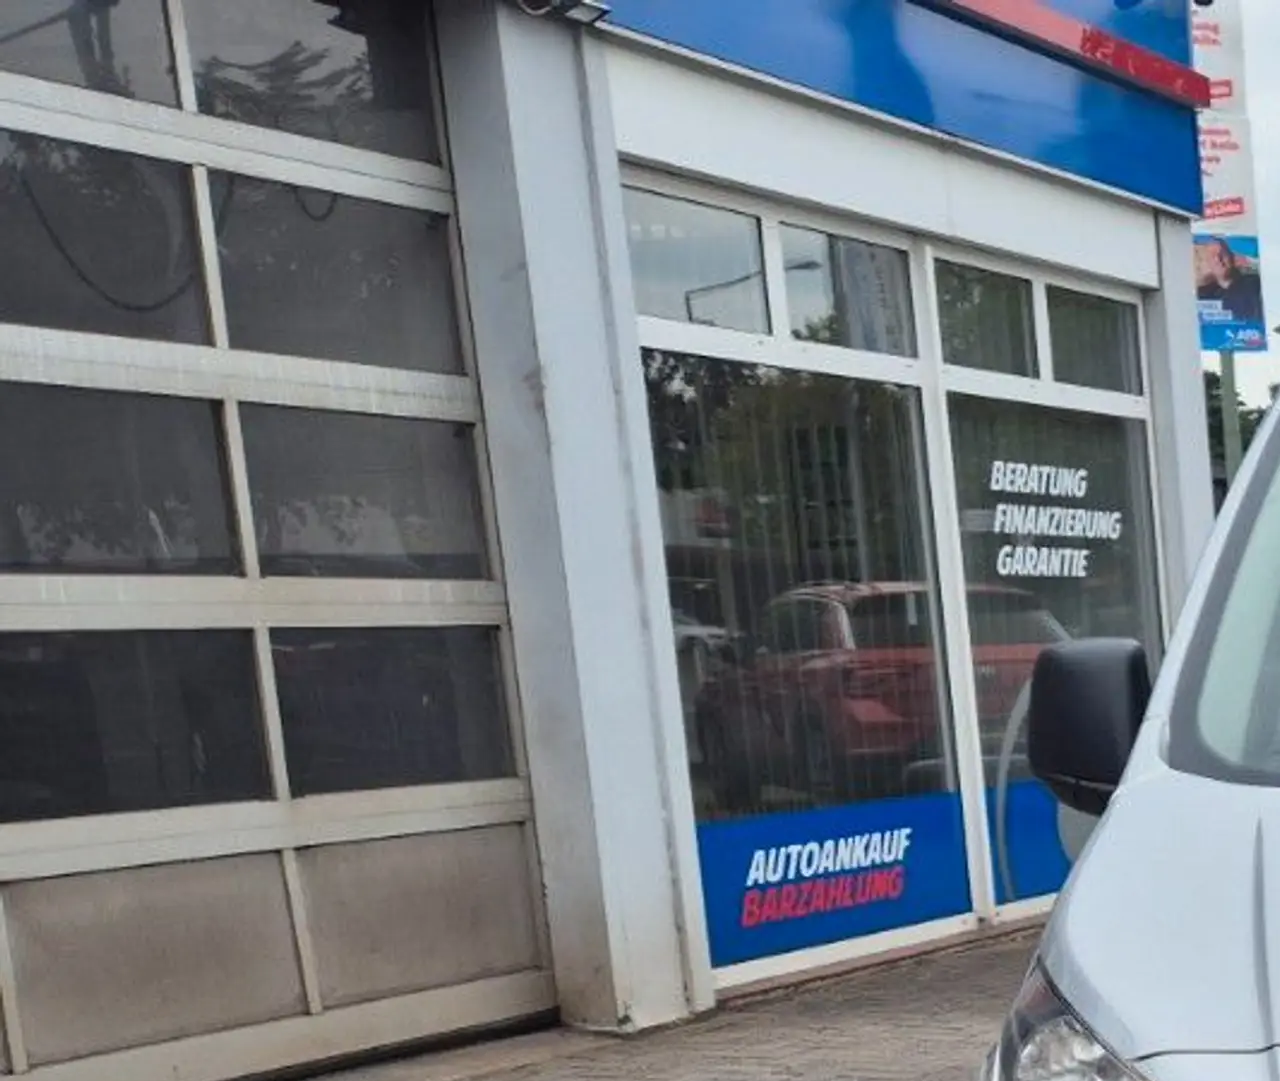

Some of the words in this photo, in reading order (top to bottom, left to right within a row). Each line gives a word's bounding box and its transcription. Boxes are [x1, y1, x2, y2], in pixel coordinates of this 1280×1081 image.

[990, 460, 1089, 498] BERATUNG
[993, 503, 1122, 540] FINANZIERUNG
[996, 545, 1091, 577] GARANTIE
[746, 828, 912, 886] AUTOANKAUF
[740, 866, 904, 928] BARZAHLUNG
